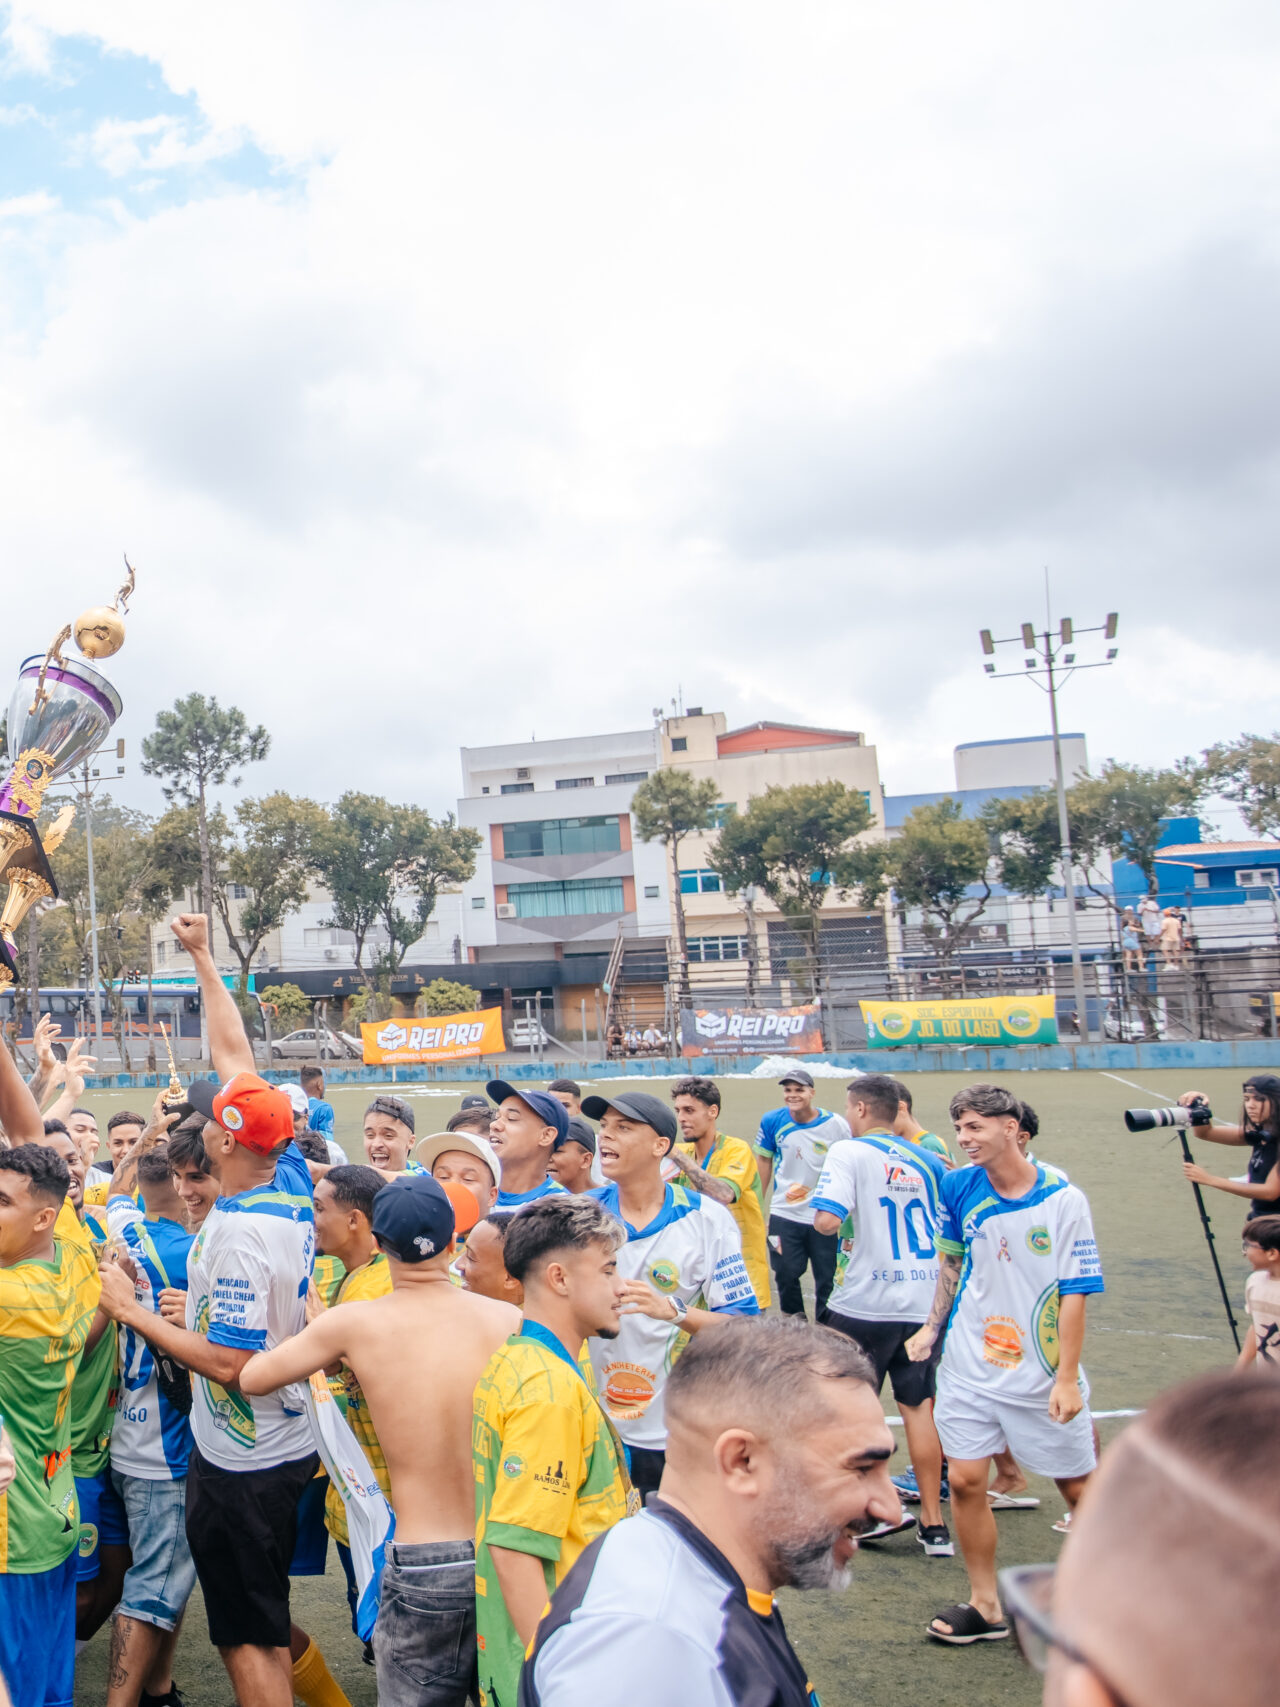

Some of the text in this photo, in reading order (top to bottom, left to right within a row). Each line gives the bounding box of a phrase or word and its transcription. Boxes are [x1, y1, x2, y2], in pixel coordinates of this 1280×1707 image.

[942, 1006, 995, 1018] ESPORTIVA
[727, 1014, 806, 1038] REI PRO
[942, 1021, 962, 1038] DO
[964, 1020, 1001, 1038] LAGO
[408, 1022, 485, 1050] REI PRO
[878, 1195, 937, 1260] 10
[910, 1269, 926, 1281] DO
[533, 1473, 560, 1486] RAMOS
